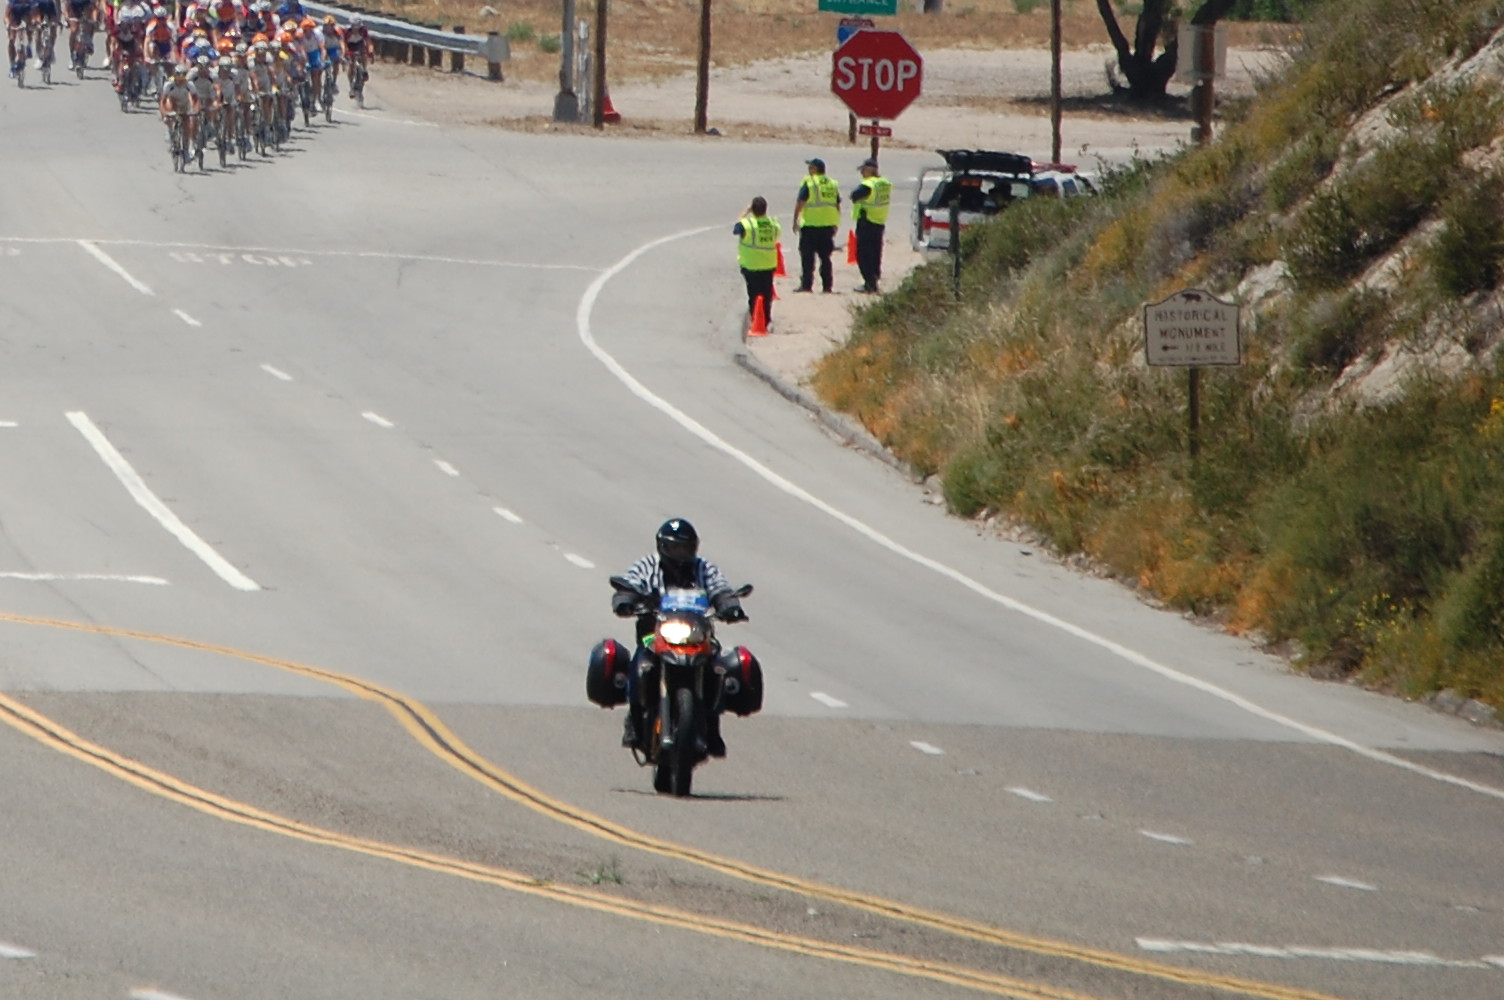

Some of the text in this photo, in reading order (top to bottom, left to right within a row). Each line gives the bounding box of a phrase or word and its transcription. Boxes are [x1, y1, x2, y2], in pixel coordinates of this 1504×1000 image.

[837, 56, 918, 92] STOP
[1154, 310, 1229, 321] HISTORICAL
[1160, 327, 1226, 339] MONUMENT
